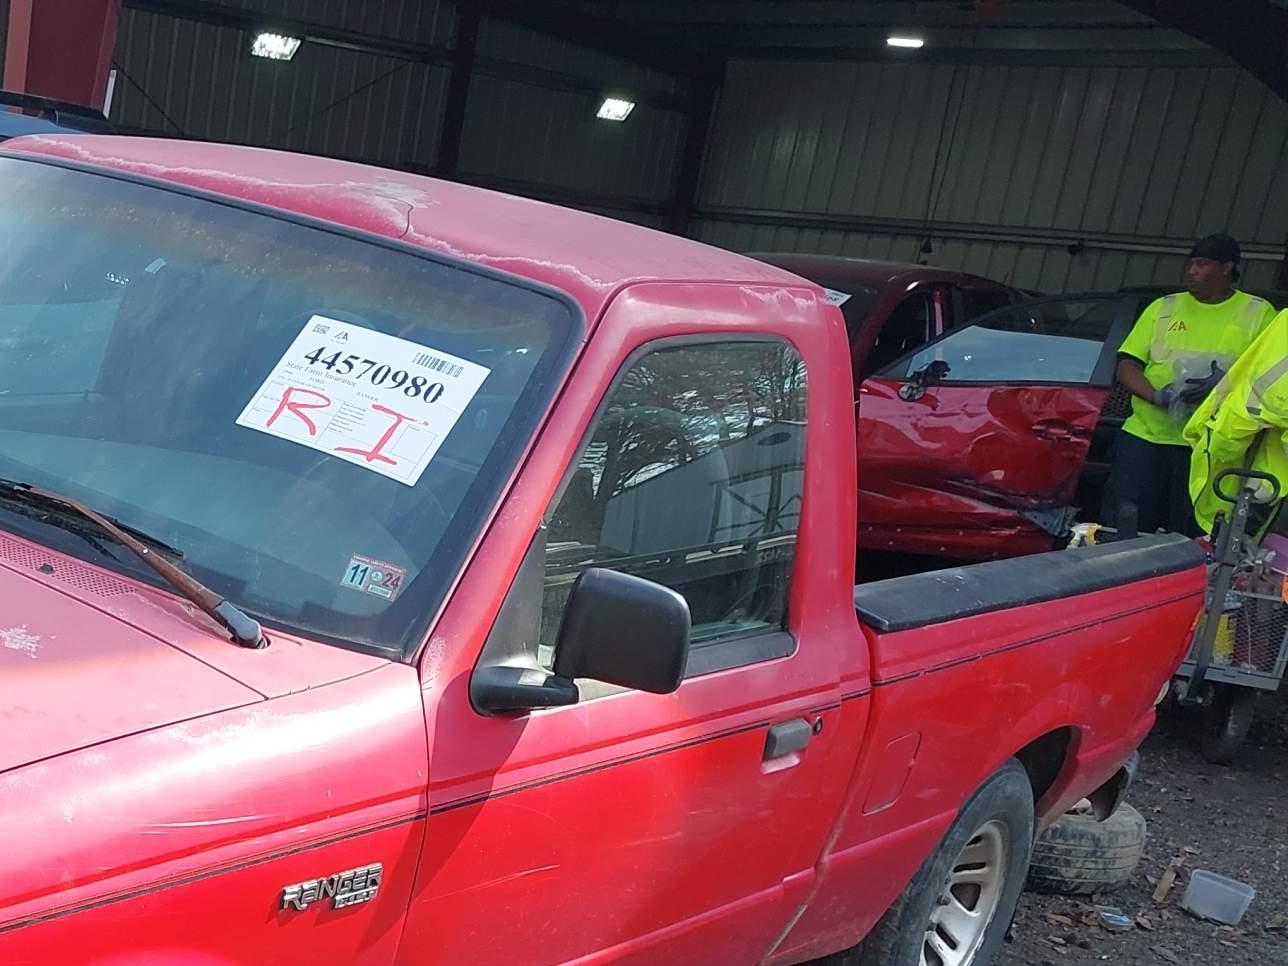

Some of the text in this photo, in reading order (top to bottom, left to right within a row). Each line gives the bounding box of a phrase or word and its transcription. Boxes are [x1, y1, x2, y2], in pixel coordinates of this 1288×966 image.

[286, 360, 304, 371] State
[304, 366, 323, 377] Farm
[325, 371, 358, 387] Insurance
[303, 346, 445, 404] 44570980
[266, 386, 331, 436] R
[350, 563, 401, 590] 11 24
[280, 862, 383, 911] RANGER
